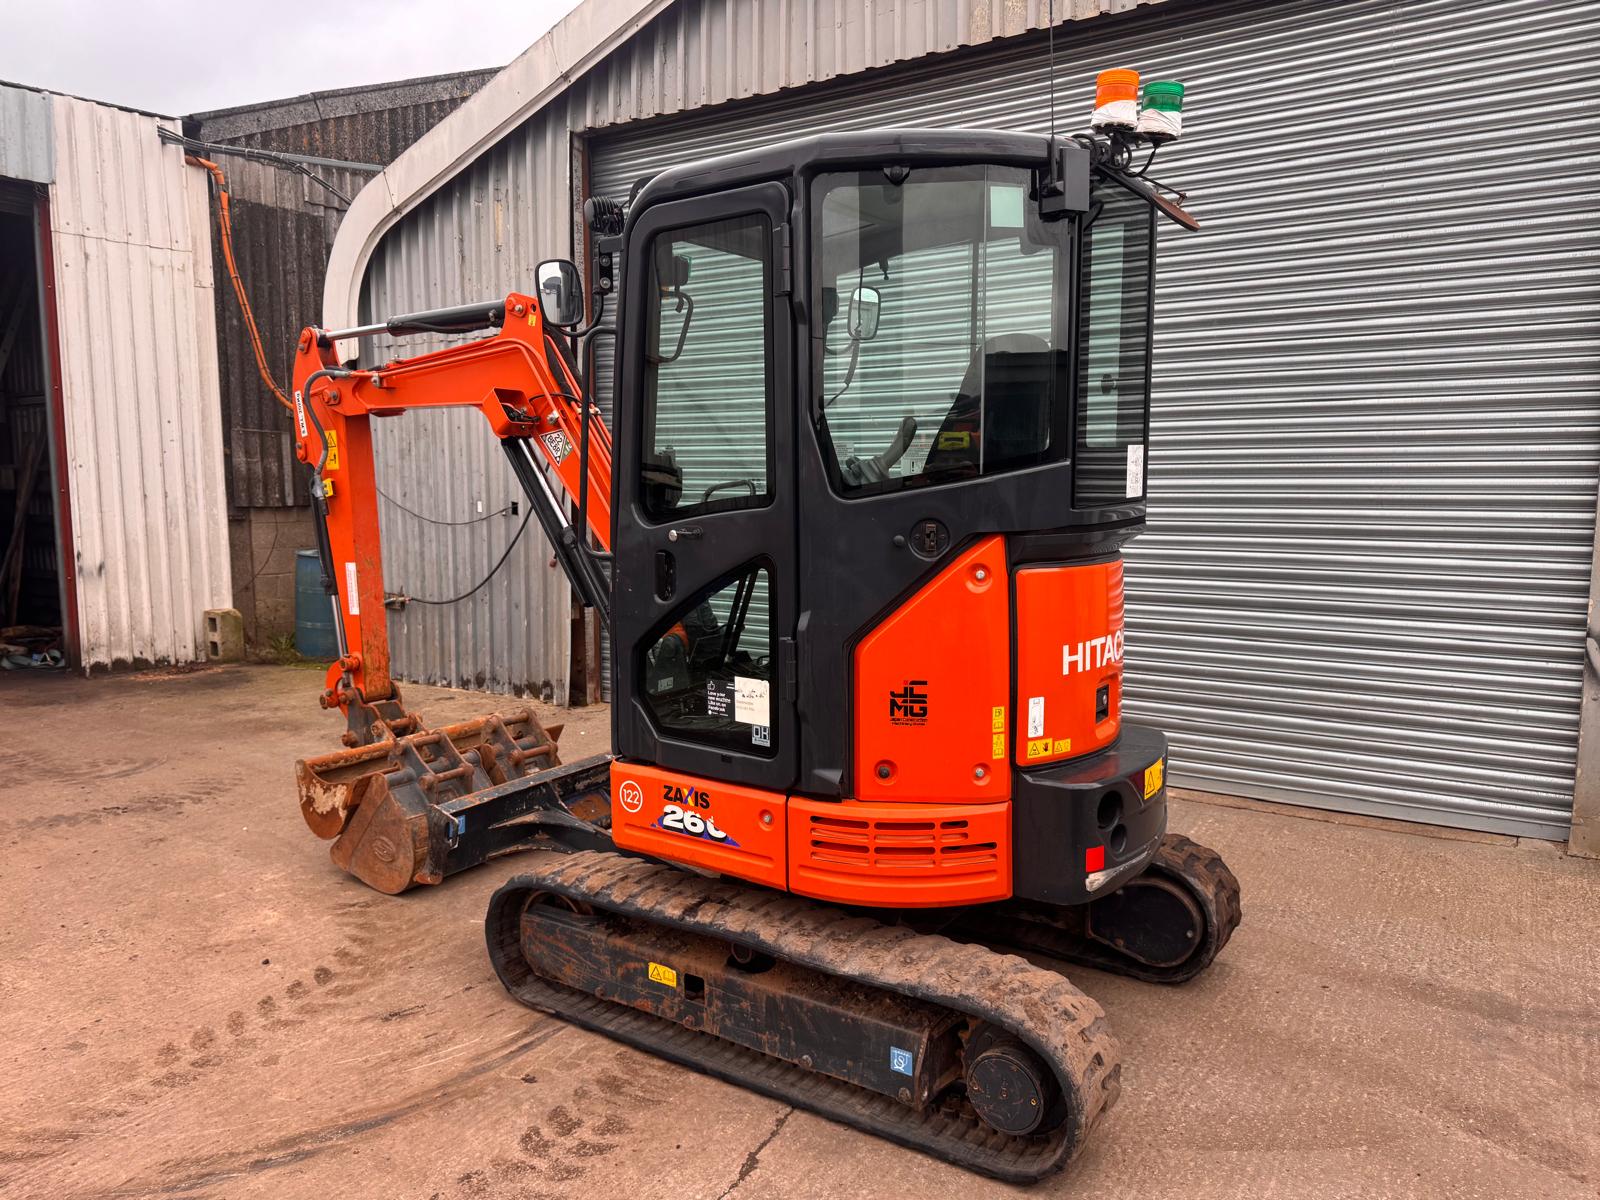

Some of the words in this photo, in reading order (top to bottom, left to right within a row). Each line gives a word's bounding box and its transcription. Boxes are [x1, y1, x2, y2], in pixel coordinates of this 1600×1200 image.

[1062, 630, 1124, 676] HITAC
[622, 788, 640, 805] 122
[663, 784, 710, 810] ZAXIS
